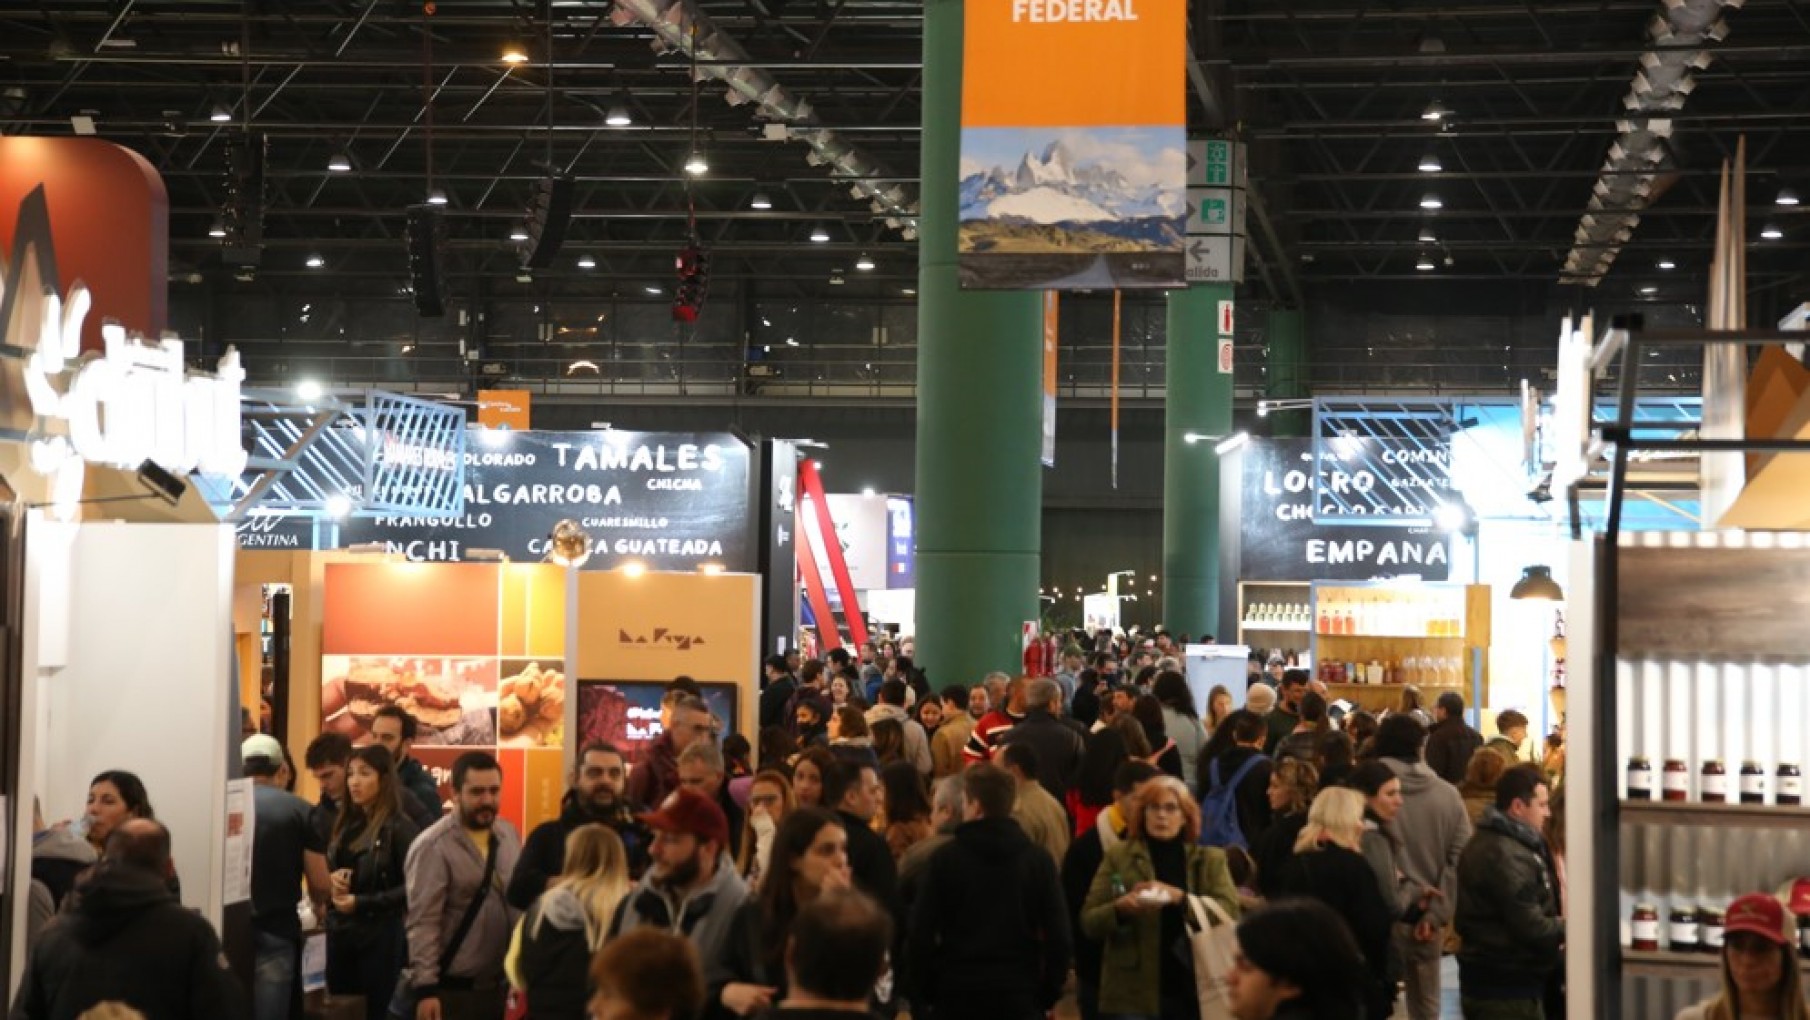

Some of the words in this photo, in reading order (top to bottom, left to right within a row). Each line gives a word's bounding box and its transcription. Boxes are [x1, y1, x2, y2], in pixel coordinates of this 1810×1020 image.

[1012, 0, 1139, 22] FEDERAL
[1185, 266, 1219, 278] alida
[553, 443, 722, 471] TAMALES
[463, 484, 623, 505] ALGARROBA
[646, 478, 703, 490] CHICHA
[372, 540, 461, 562] NCHI
[614, 538, 723, 556] GUATEADA
